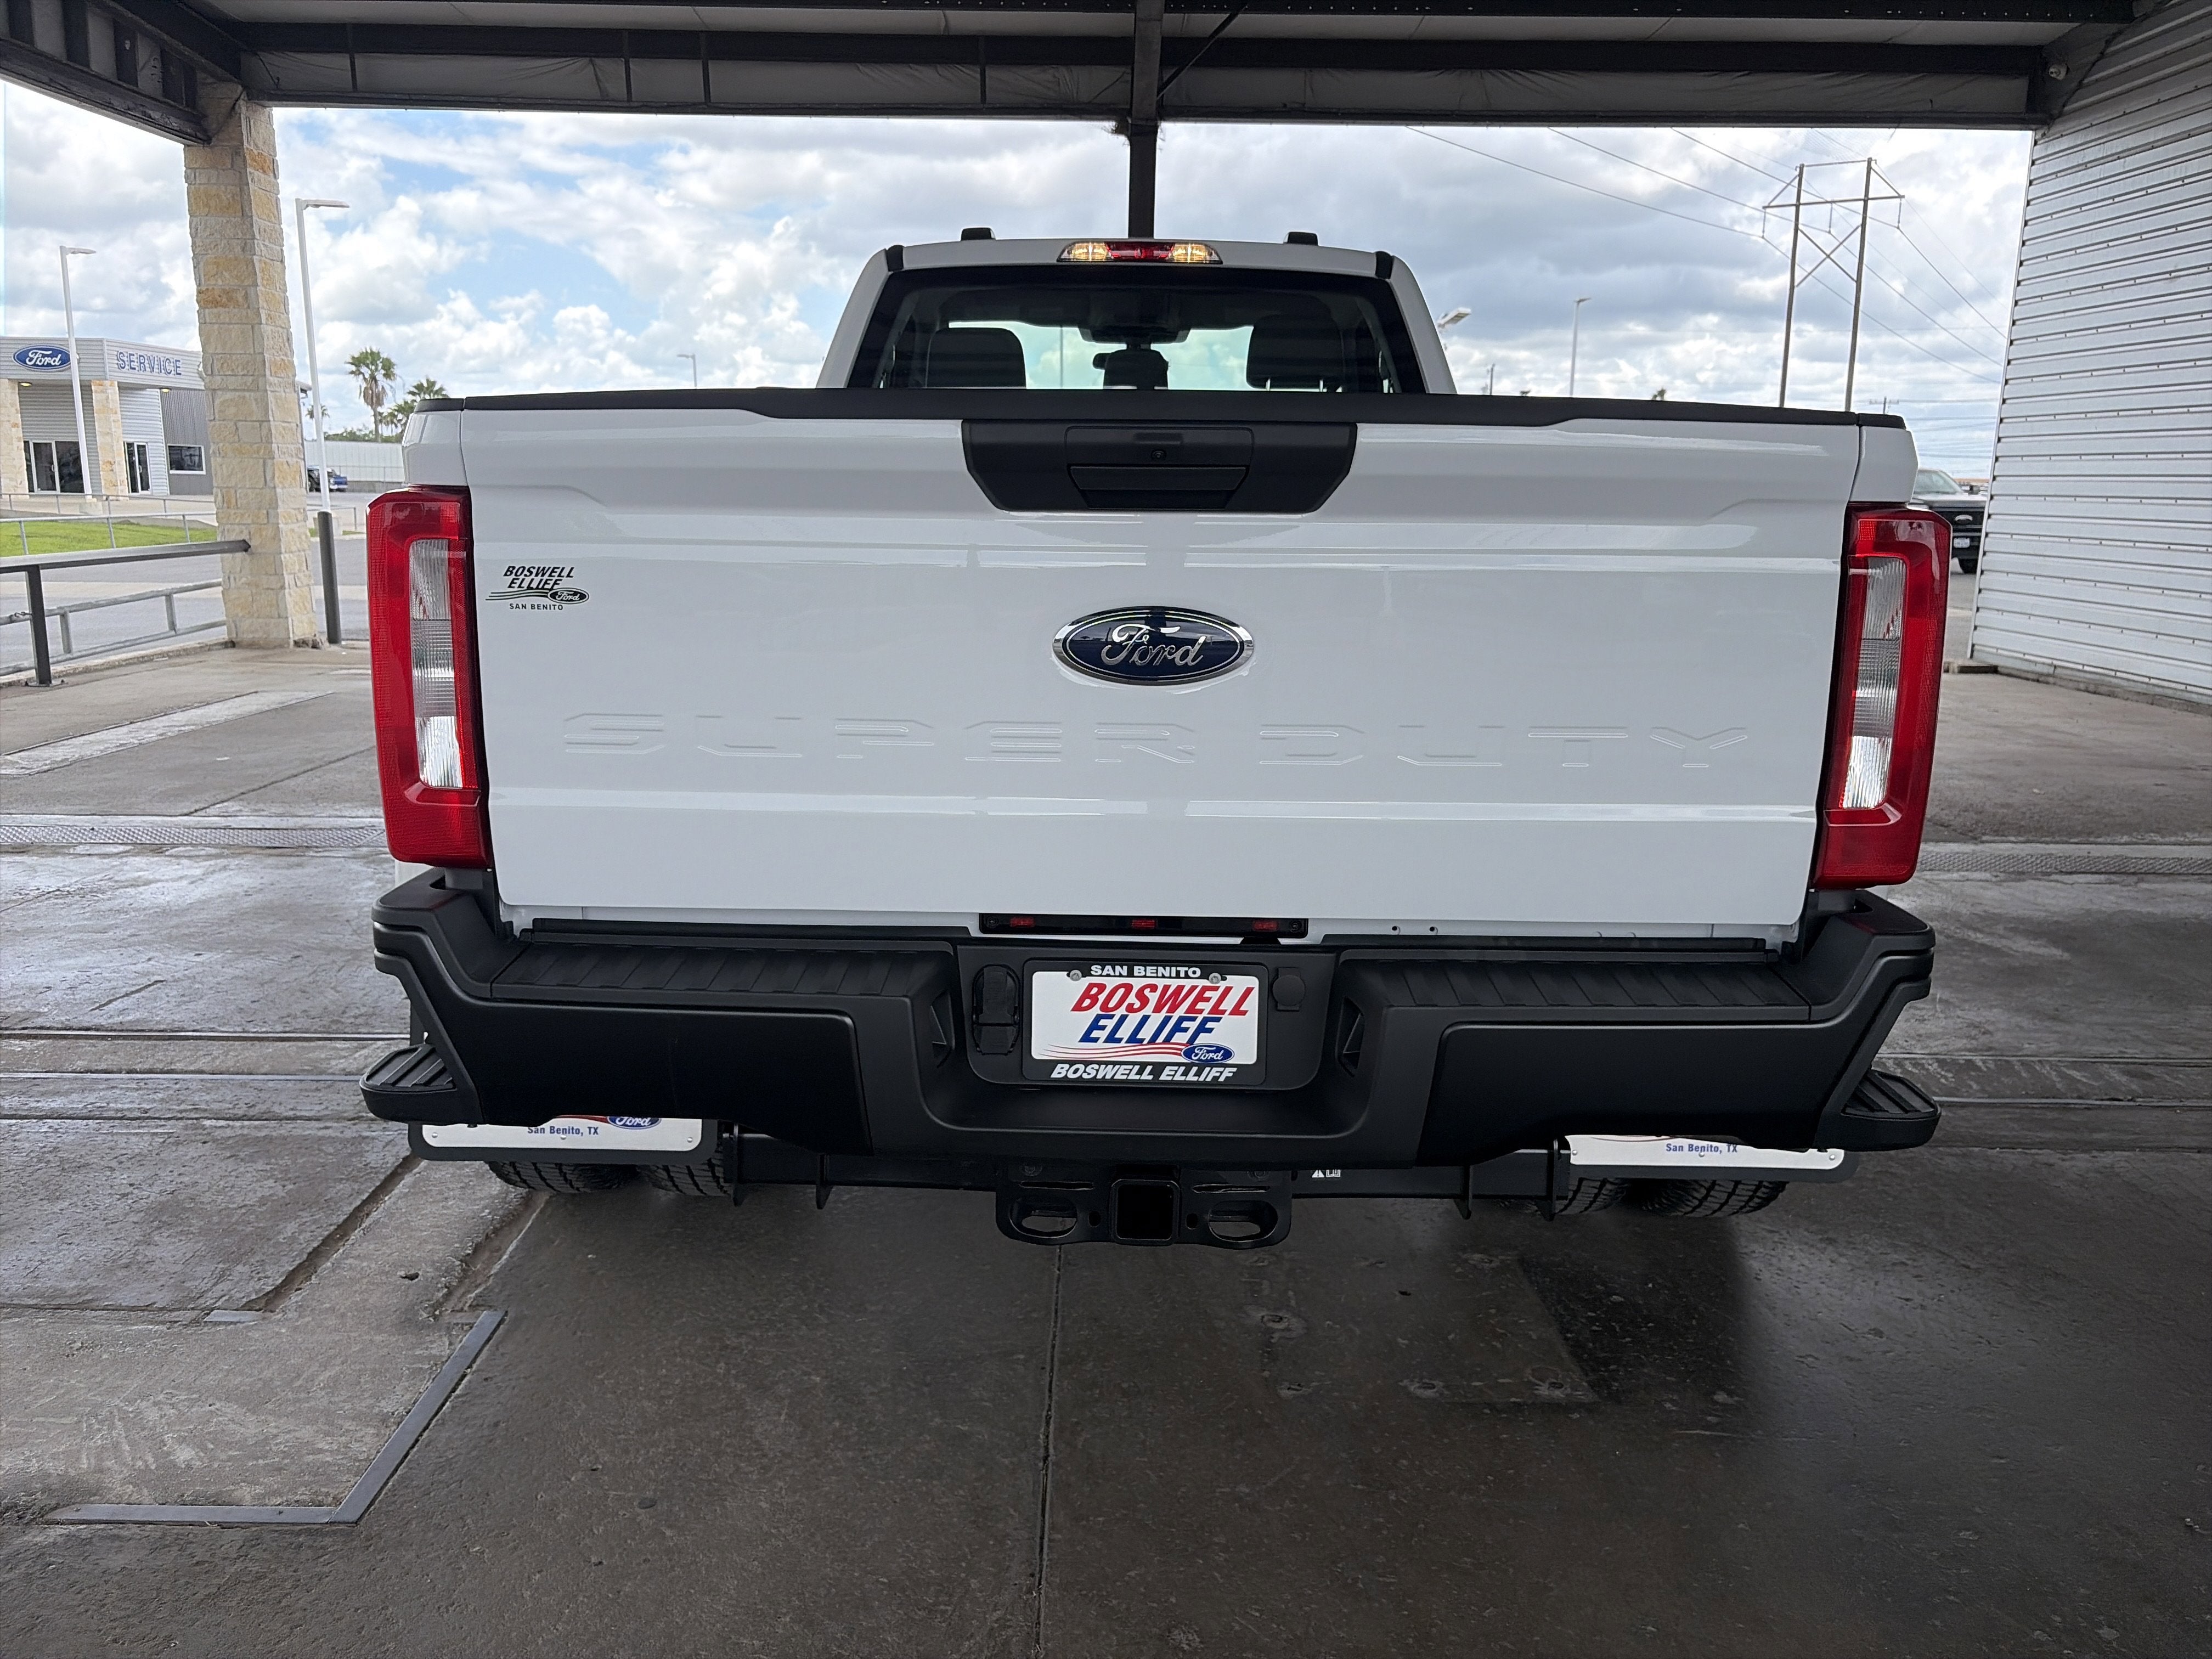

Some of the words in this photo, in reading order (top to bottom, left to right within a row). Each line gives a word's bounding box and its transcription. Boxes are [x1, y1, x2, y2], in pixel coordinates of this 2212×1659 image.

[26, 350, 61, 365] Ford
[117, 351, 182, 376] SERVICE
[503, 566, 575, 578] BOSWELL
[507, 578, 563, 589] ELLIFF
[555, 590, 580, 601] Ford
[1101, 624, 1206, 666] Ford
[564, 713, 1195, 763] SUPER
[1258, 723, 1748, 768] DUTY
[1091, 965, 1128, 977] SAN
[1133, 966, 1201, 978] BENITO
[1070, 982, 1255, 1016] BOSWELL
[1078, 1013, 1223, 1045] ELLIFF
[1191, 1046, 1224, 1061] Ford
[1050, 1063, 1154, 1080] BOSWELL
[1159, 1065, 1237, 1082] ELLIFF
[527, 1126, 545, 1135] San
[549, 1126, 584, 1136] Benito,
[587, 1126, 599, 1135] TX
[1666, 1143, 1684, 1152] San
[1688, 1144, 1723, 1154] Benito,
[1726, 1144, 1738, 1152] TX
